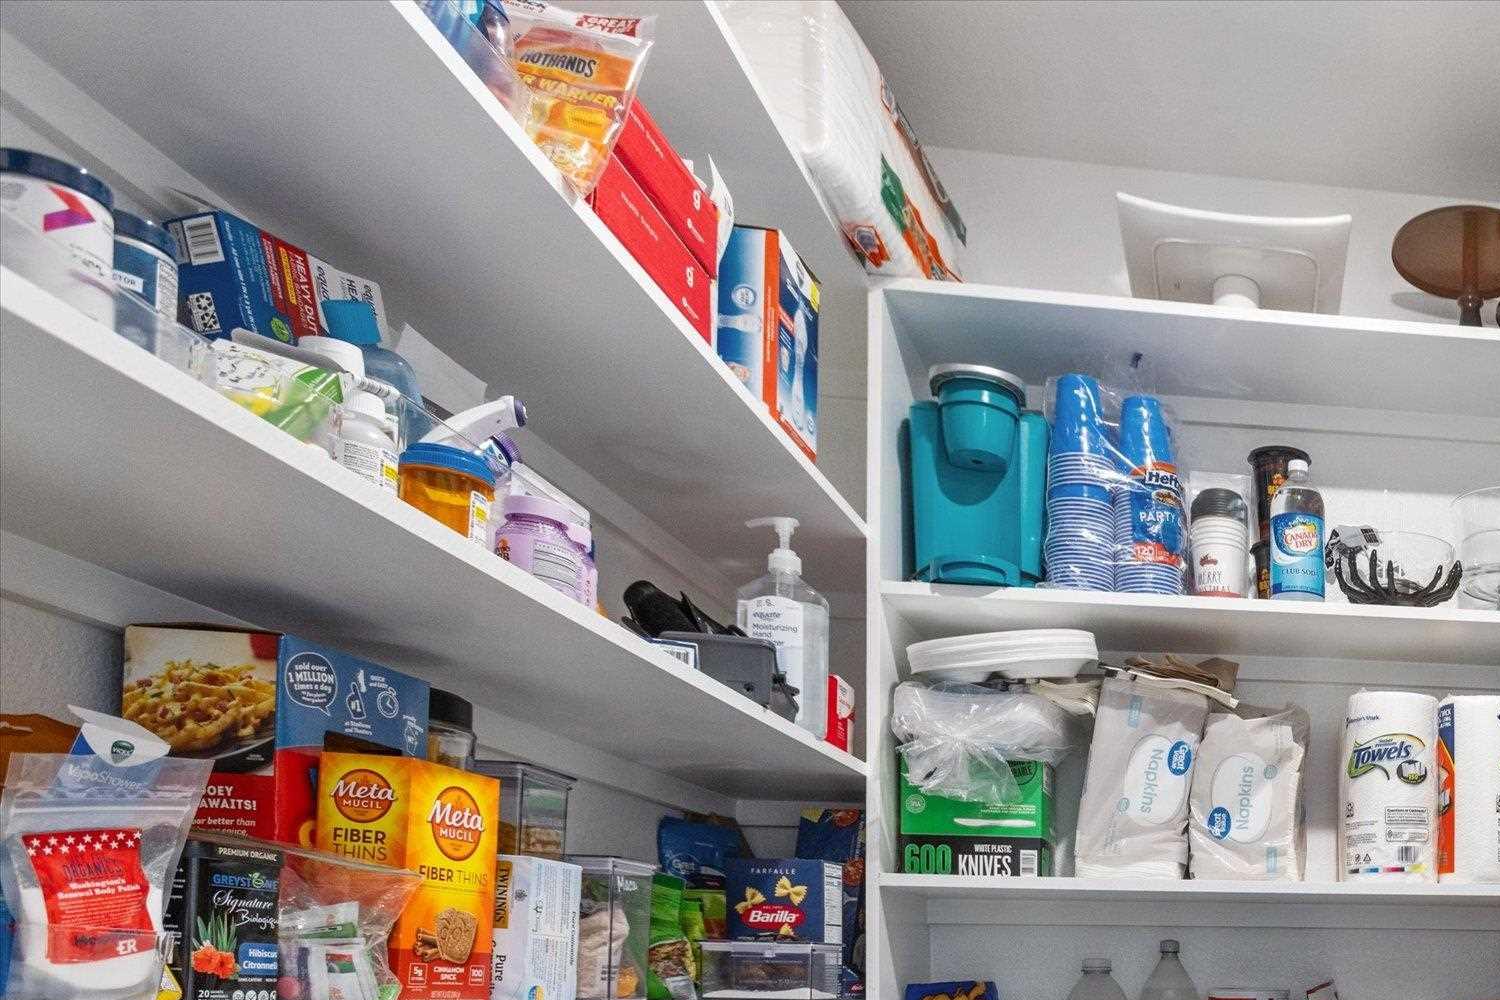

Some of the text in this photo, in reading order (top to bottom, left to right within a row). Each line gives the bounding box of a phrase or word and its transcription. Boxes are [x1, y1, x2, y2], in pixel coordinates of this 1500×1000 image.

[1295, 539, 1313, 550] DRY
[752, 623, 797, 633] Moisturizing
[295, 673, 334, 683] MILLION
[1353, 741, 1412, 768] Towels
[1140, 749, 1163, 813] Napkins
[332, 779, 396, 801] Meta
[200, 799, 257, 811] AWAITS!
[343, 799, 382, 810] MUCIL
[1235, 766, 1254, 830] Napkins
[208, 817, 256, 827] better than
[427, 799, 485, 832] Meta
[333, 828, 387, 844] FIBER
[439, 829, 474, 842] MUCIL
[218, 847, 249, 858] PREMIUM
[333, 843, 388, 861] THINS
[974, 844, 1012, 853] WHITE PLASTIC
[904, 844, 952, 874] 600
[958, 854, 1012, 877] KNIVES
[419, 865, 488, 886] FIBER THINS
[750, 867, 796, 875] FARFALLE
[213, 890, 274, 913] Signature
[496, 868, 509, 923] TWININGS
[749, 910, 798, 923] Barilla
[471, 968, 483, 978] 100
[495, 955, 506, 982] Pure
[198, 990, 209, 998] 20
